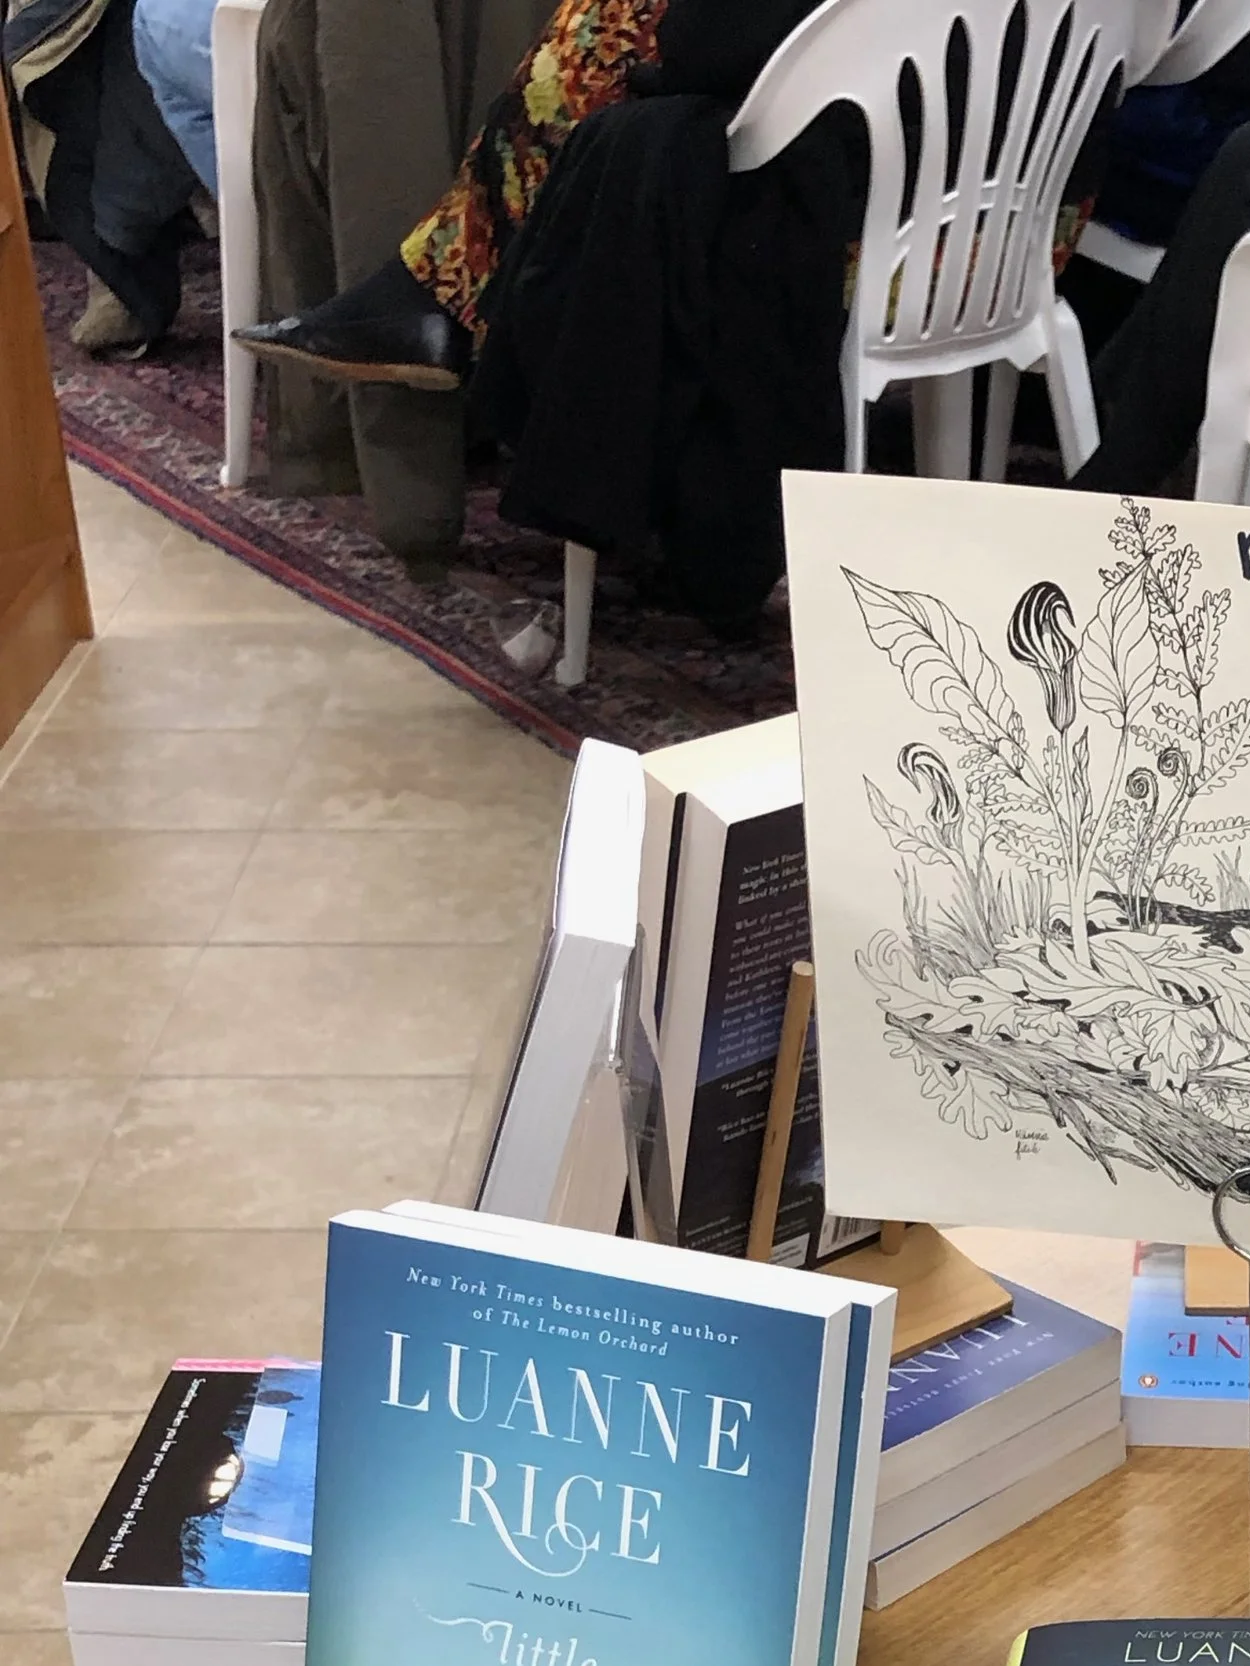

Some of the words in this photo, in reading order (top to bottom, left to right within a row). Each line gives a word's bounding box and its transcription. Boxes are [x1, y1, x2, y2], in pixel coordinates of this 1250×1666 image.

[407, 1266, 441, 1287] New
[451, 1275, 487, 1296] York
[496, 1284, 543, 1308] Times
[552, 1296, 662, 1335] bestselling
[671, 1321, 739, 1346] author
[473, 1308, 494, 1322] of
[502, 1310, 529, 1329] The
[537, 1318, 590, 1341] Lemon
[599, 1330, 669, 1356] Orchard
[887, 1314, 1029, 1391] LUAN
[381, 1331, 751, 1477] LUANNE
[451, 1450, 662, 1577] RICE
[515, 1590, 525, 1600] A
[533, 1593, 583, 1613] NOVEL
[1135, 1630, 1177, 1640] NEW
[1183, 1630, 1224, 1640] YORK
